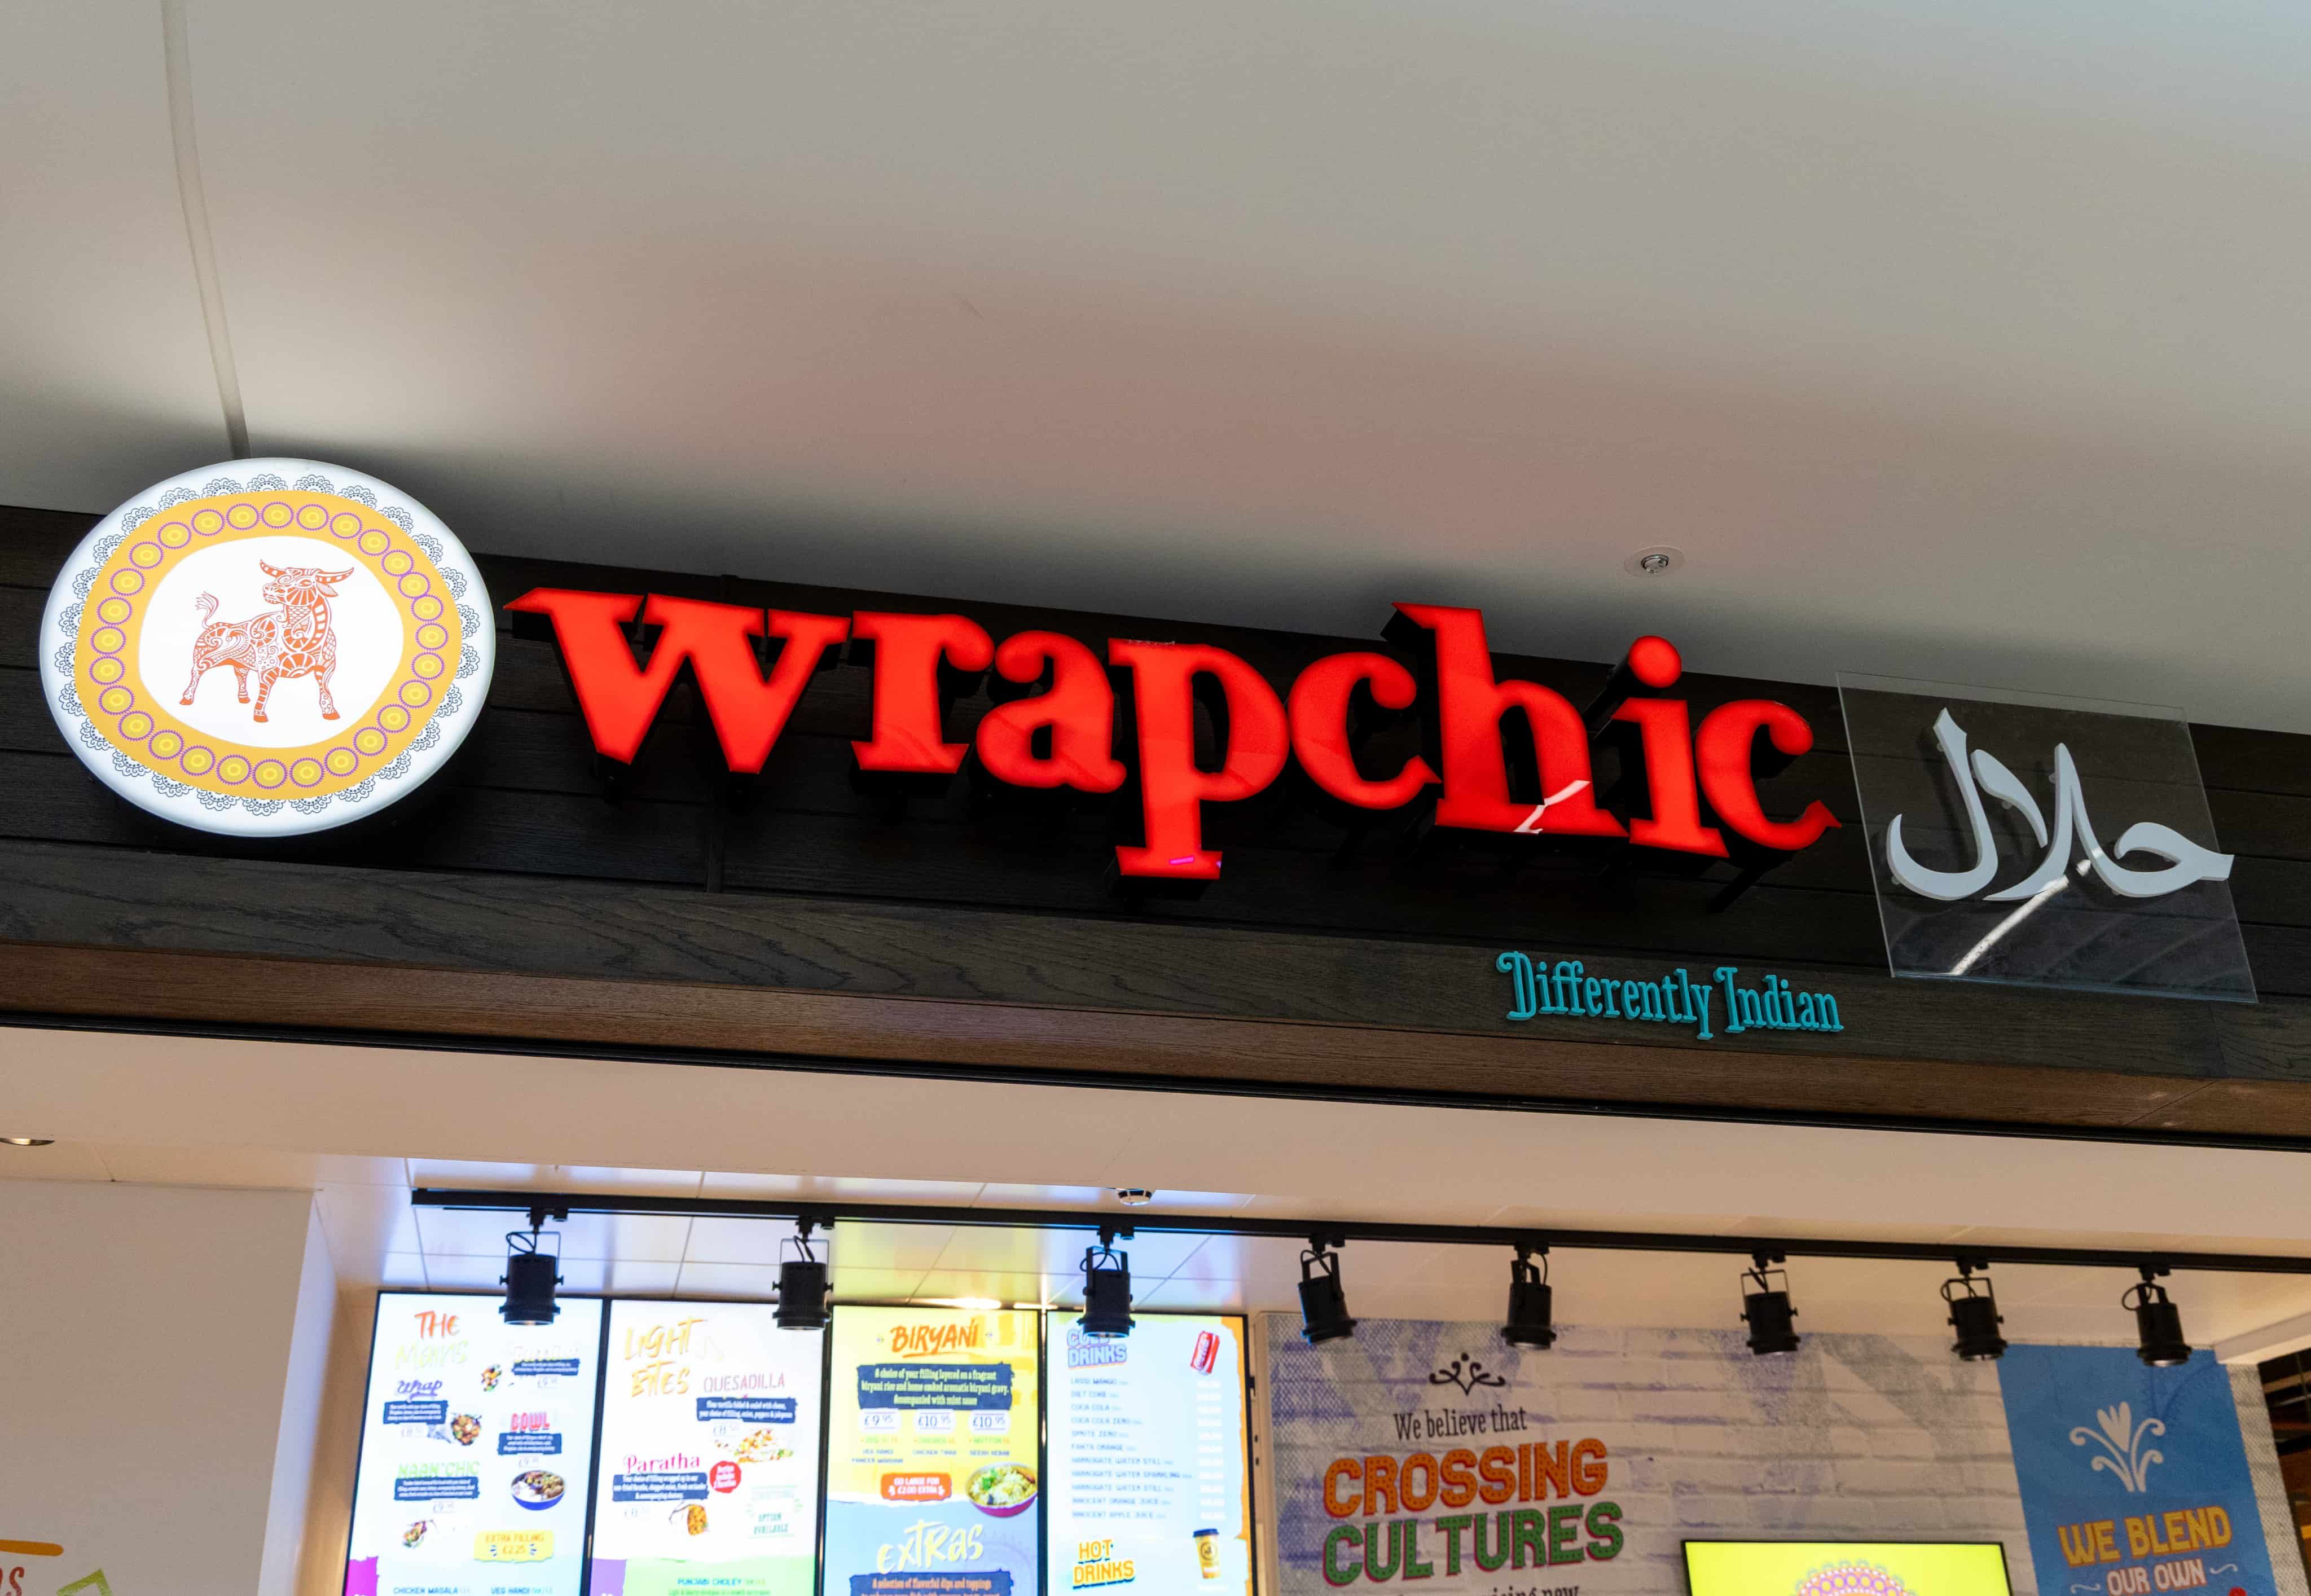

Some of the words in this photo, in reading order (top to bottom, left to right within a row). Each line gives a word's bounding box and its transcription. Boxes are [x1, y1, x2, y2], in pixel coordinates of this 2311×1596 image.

[506, 589, 1842, 880] wrapchic
[1886, 707, 2235, 901] حلال
[1496, 951, 1713, 1040] Differently
[1713, 967, 1844, 1032] Indian
[414, 1311, 460, 1340] THE
[890, 1318, 979, 1353] BIRYANI
[1067, 1343, 1127, 1368] DRINKS
[703, 1372, 786, 1393] QUESADILLA
[511, 1411, 551, 1431] BOWL
[1393, 1412, 1421, 1440] We
[1425, 1408, 1487, 1437] believe
[1491, 1404, 1527, 1433] that
[622, 1452, 700, 1474] Paratha
[1324, 1438, 1608, 1519] CROSSING
[893, 1478, 904, 1486] GO
[926, 1478, 940, 1486] FOR
[486, 1533, 510, 1543] EXTRA
[513, 1532, 545, 1542] FILLING
[1078, 1539, 1113, 1560] HOT
[1323, 1501, 1624, 1586] CULTURES
[2057, 1519, 2121, 1568] WE
[2123, 1505, 2233, 1559] BLEND
[1073, 1559, 1135, 1585] DRINKS
[2106, 1566, 2151, 1596] OUR
[2152, 1558, 2207, 1592] OWN
